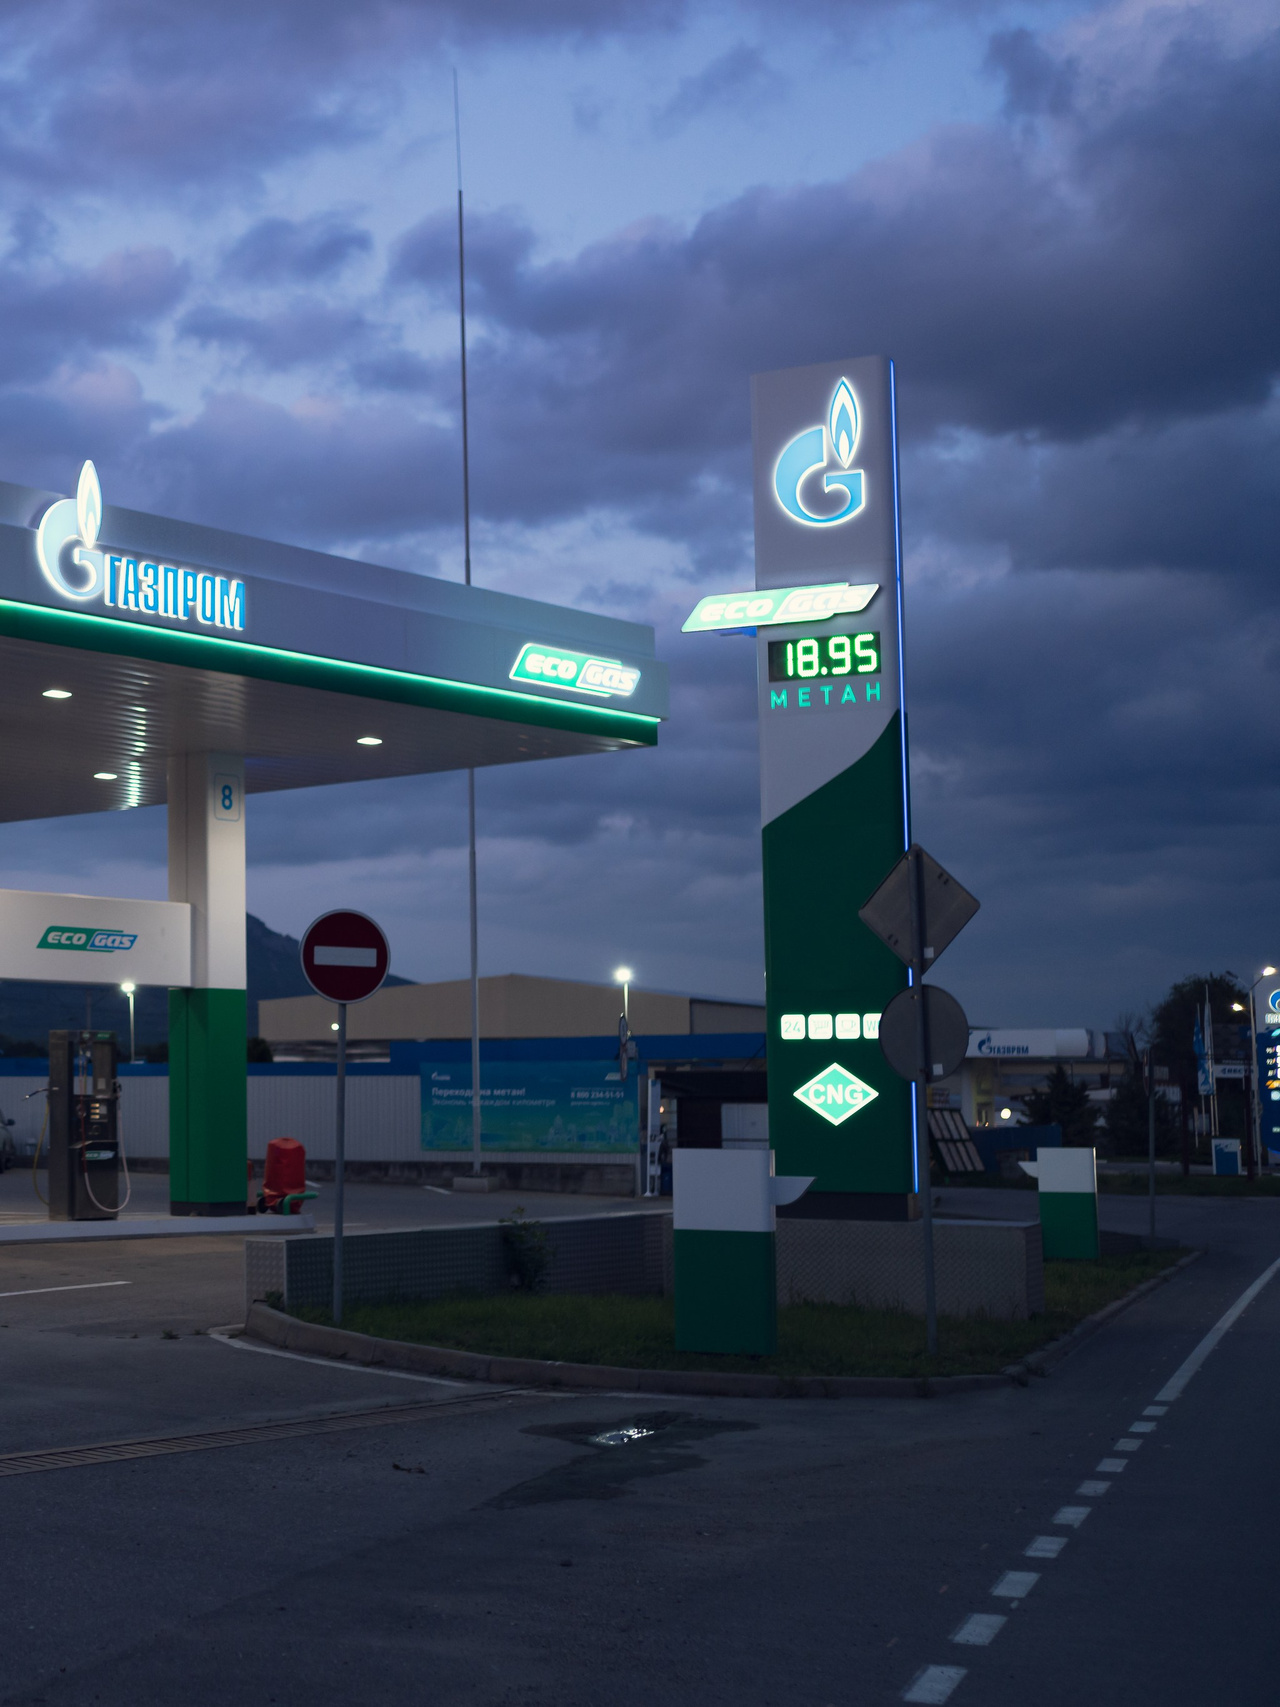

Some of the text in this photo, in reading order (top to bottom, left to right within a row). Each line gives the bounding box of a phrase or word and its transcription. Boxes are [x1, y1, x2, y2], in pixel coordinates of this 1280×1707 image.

[104, 553, 246, 631] ГАЗПРОМ
[786, 632, 877, 678] 18.95
[770, 682, 881, 710] МЕТАН
[221, 783, 233, 810] 8
[784, 1020, 801, 1033] 24
[431, 1087, 475, 1098] Переход
[808, 1083, 864, 1105] CNG
